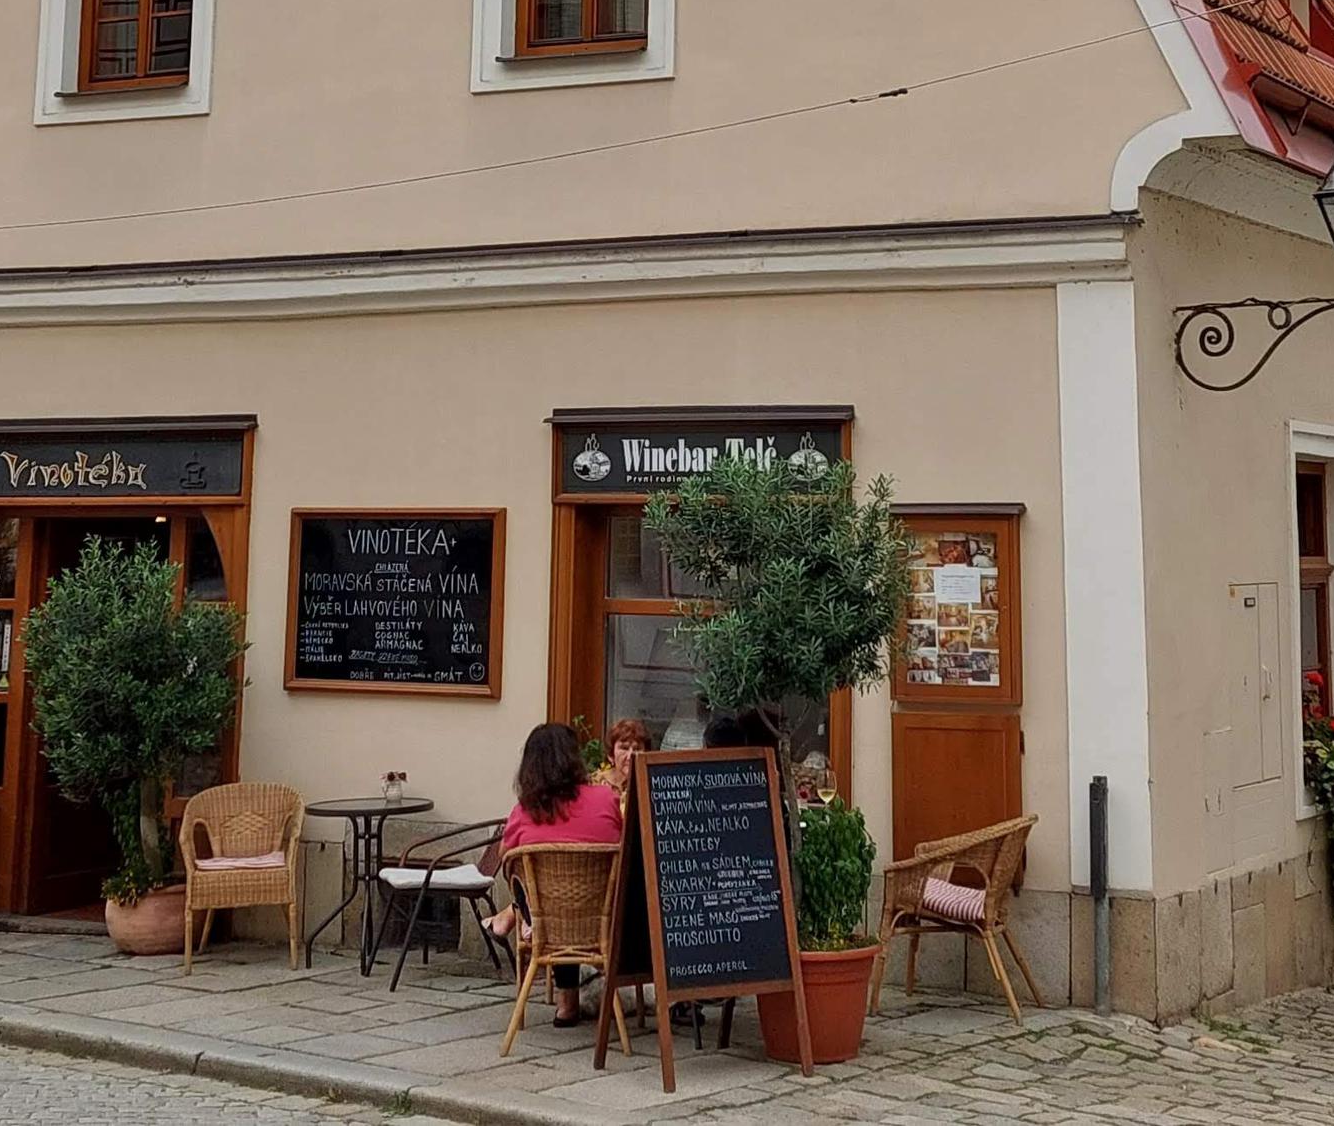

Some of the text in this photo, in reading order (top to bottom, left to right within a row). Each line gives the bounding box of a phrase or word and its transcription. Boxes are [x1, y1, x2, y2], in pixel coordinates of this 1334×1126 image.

[622, 435, 778, 474] Winebar Telč
[0, 450, 148, 490] Vinotéka
[626, 475, 653, 483] První
[304, 565, 480, 595] MORAVSKÁ STÁČENÁ VÍNA
[304, 595, 465, 619] VÝBĚR LAHVOVÉHO VÍNA
[453, 620, 475, 632] KÁVA
[374, 631, 410, 640] COGNAC
[374, 639, 424, 650] ARMAGNAC
[451, 643, 483, 654] NEALKO
[651, 765, 767, 789] MORAVSKÁ SUDOVÁ VÍNA
[654, 800, 695, 816] LAHVOVÁ
[708, 816, 750, 833] NEALKO
[659, 858, 700, 875] CHLEBA
[660, 875, 712, 893] ŠKVARKY
[664, 909, 705, 929] UZENÉ
[709, 911, 739, 925] MASO
[667, 928, 741, 948] PROSCIUTTO
